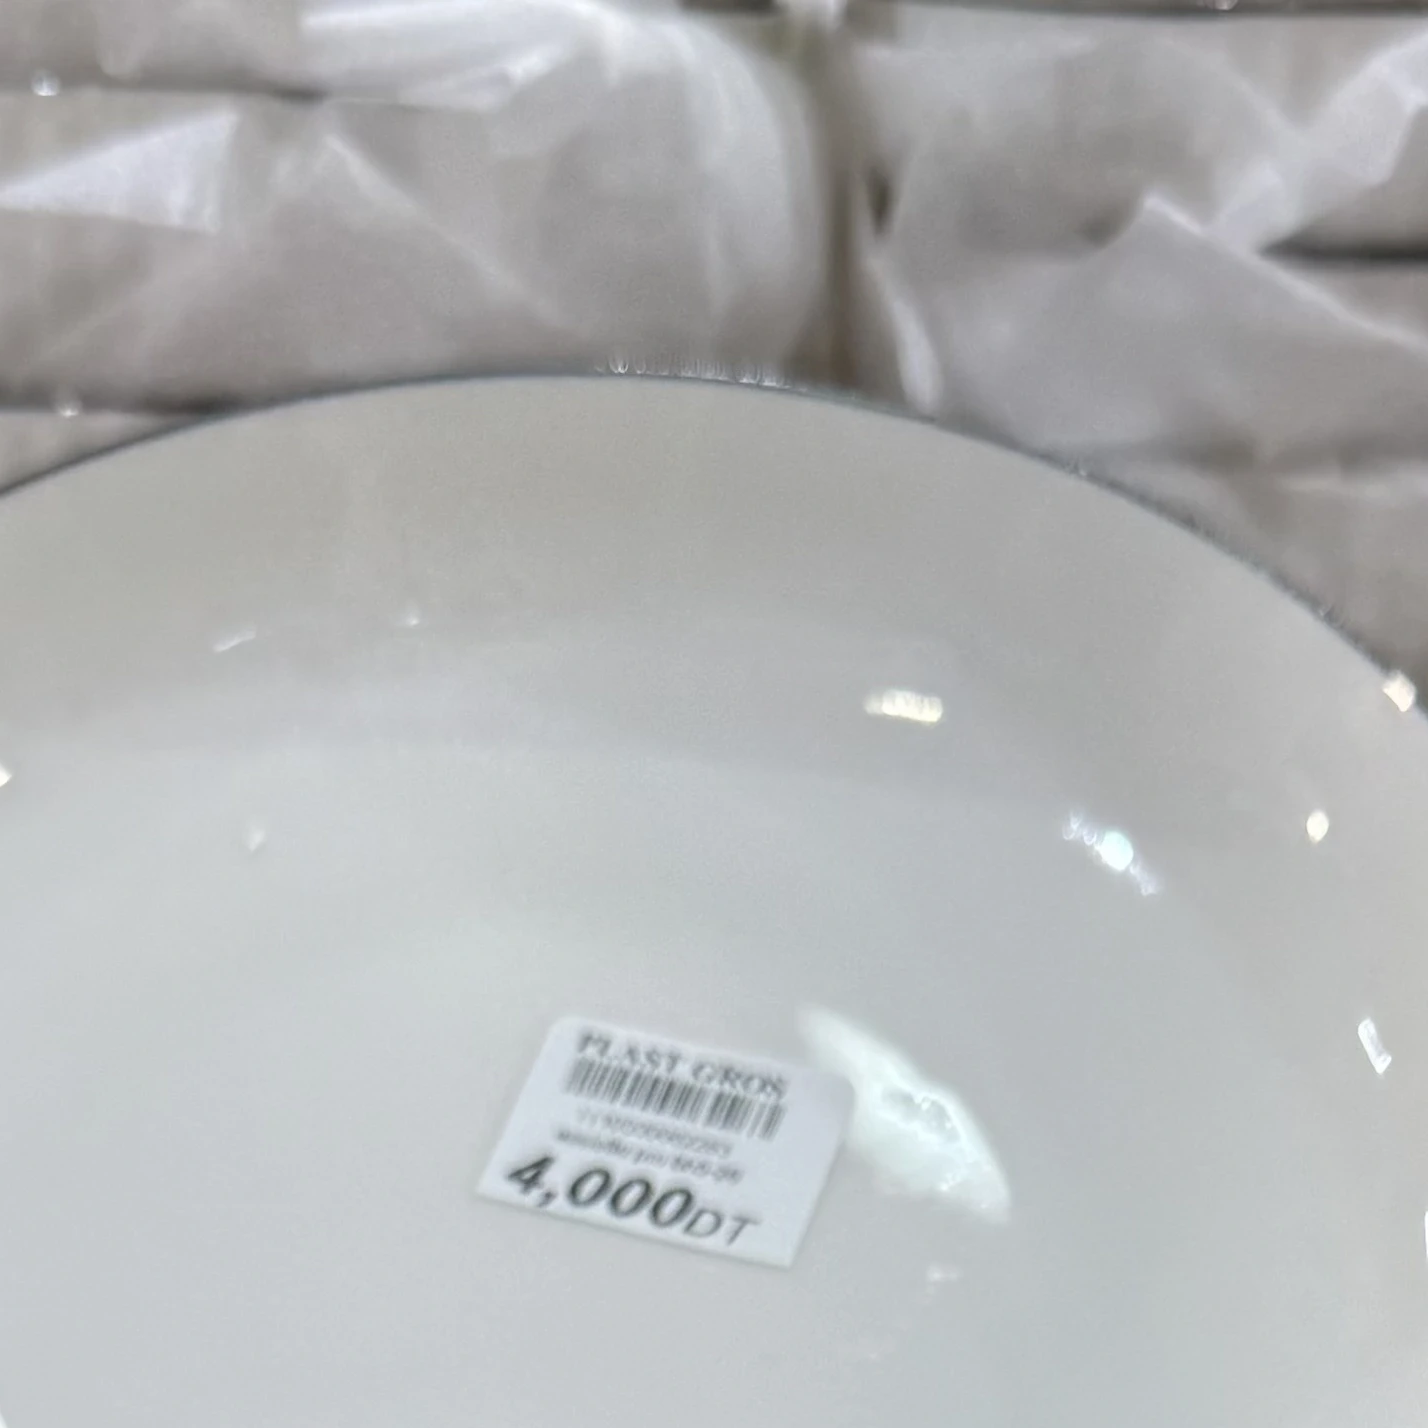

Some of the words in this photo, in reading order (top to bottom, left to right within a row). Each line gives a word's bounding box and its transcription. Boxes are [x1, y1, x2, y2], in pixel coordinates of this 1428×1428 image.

[576, 1030, 682, 1075] PLAST
[691, 1061, 788, 1099] GROS
[506, 1154, 763, 1245] 4,000DT
